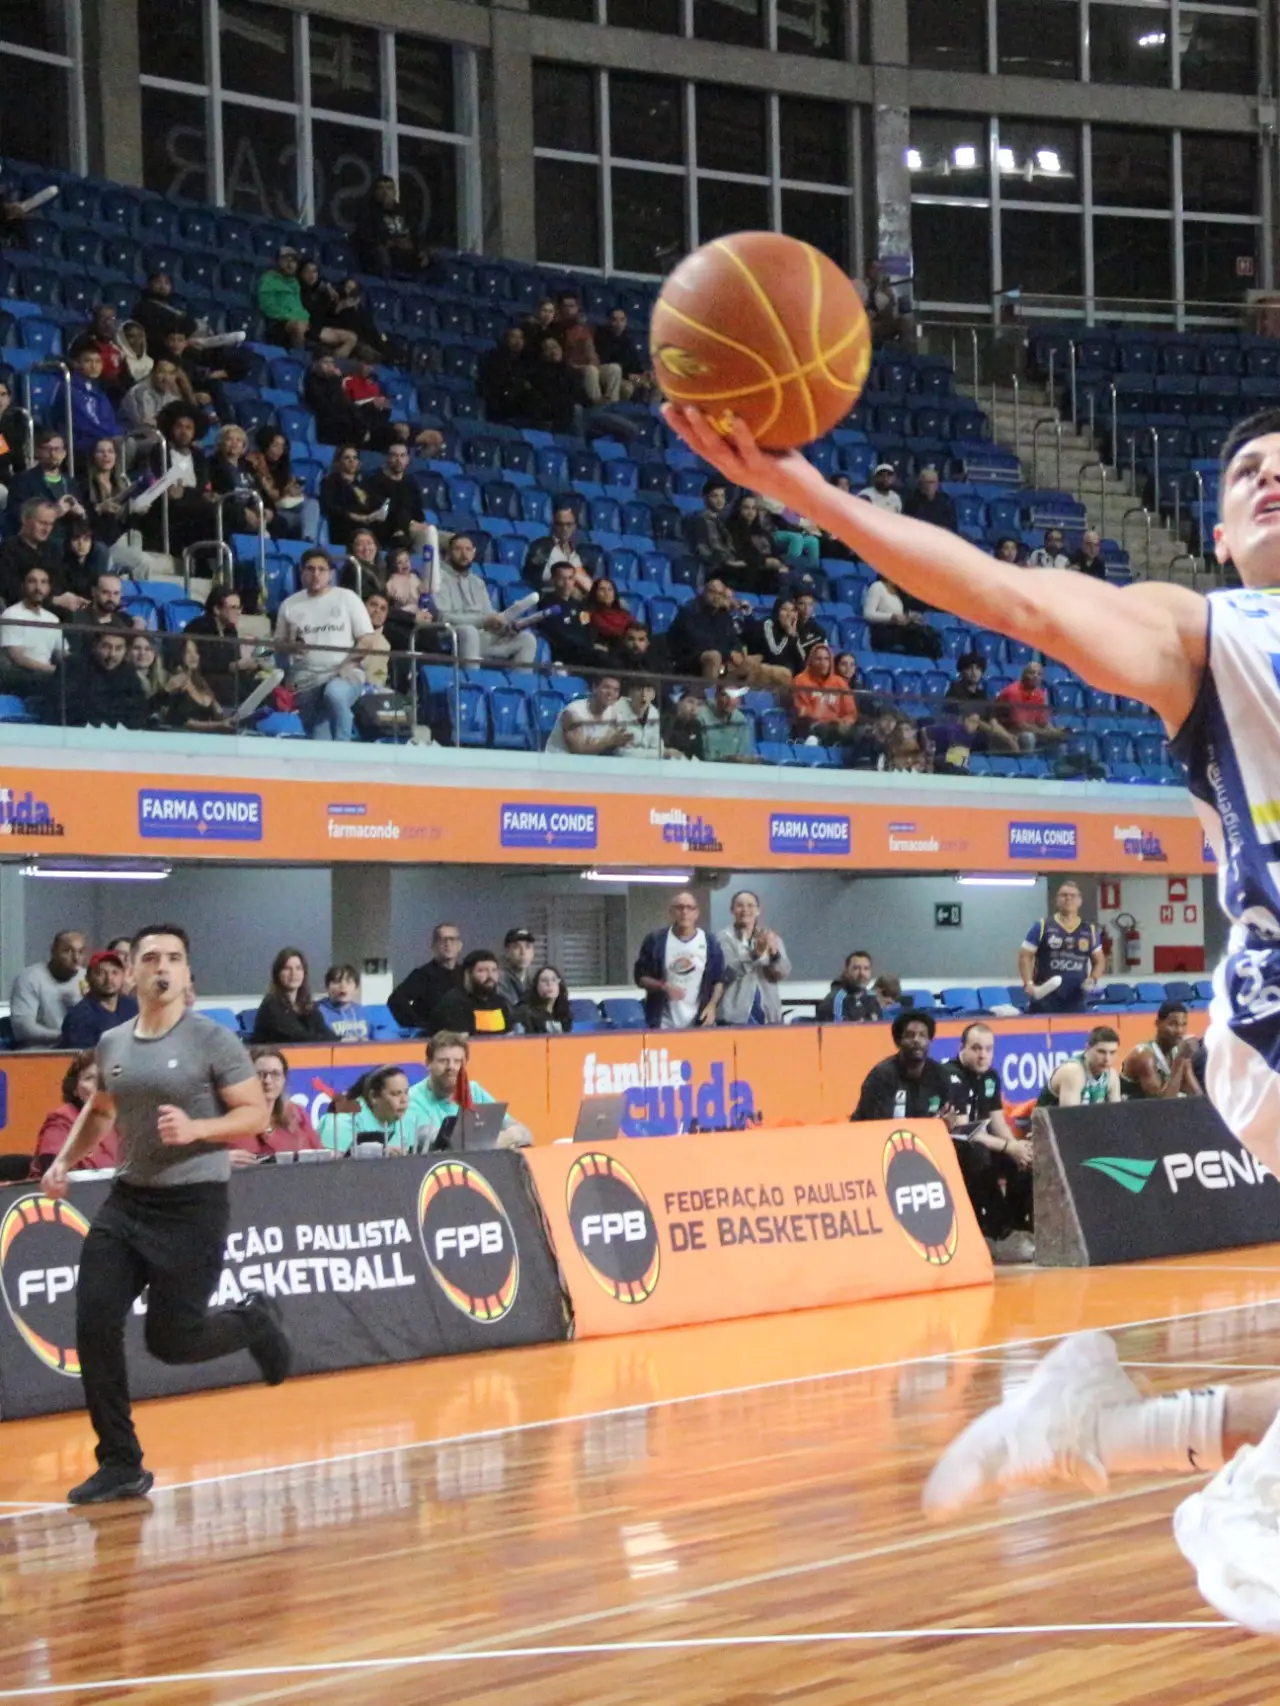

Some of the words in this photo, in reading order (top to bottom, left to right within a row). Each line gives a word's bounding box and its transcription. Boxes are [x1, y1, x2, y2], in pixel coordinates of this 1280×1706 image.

[0, 790, 49, 824] ida
[142, 798, 199, 820] FARMA
[202, 801, 260, 823] CONDE
[503, 811, 548, 831] FARMA
[551, 813, 595, 833] CONDE
[771, 820, 809, 838] FARMA
[811, 822, 849, 840] CONDE
[1010, 828, 1042, 844] FARMA
[1044, 830, 1076, 846] CONDE
[619, 1060, 754, 1139] cuida
[664, 1184, 785, 1215] FEDERAÇÃO
[795, 1179, 878, 1206] PAULISTA
[895, 1182, 946, 1214] FPB
[222, 1225, 284, 1262] ÇÃO
[296, 1217, 412, 1251] PAULISTA
[435, 1221, 504, 1261] FPB
[580, 1210, 647, 1247] FPB
[669, 1217, 707, 1253] DE
[719, 1207, 883, 1247] BASKETBALL
